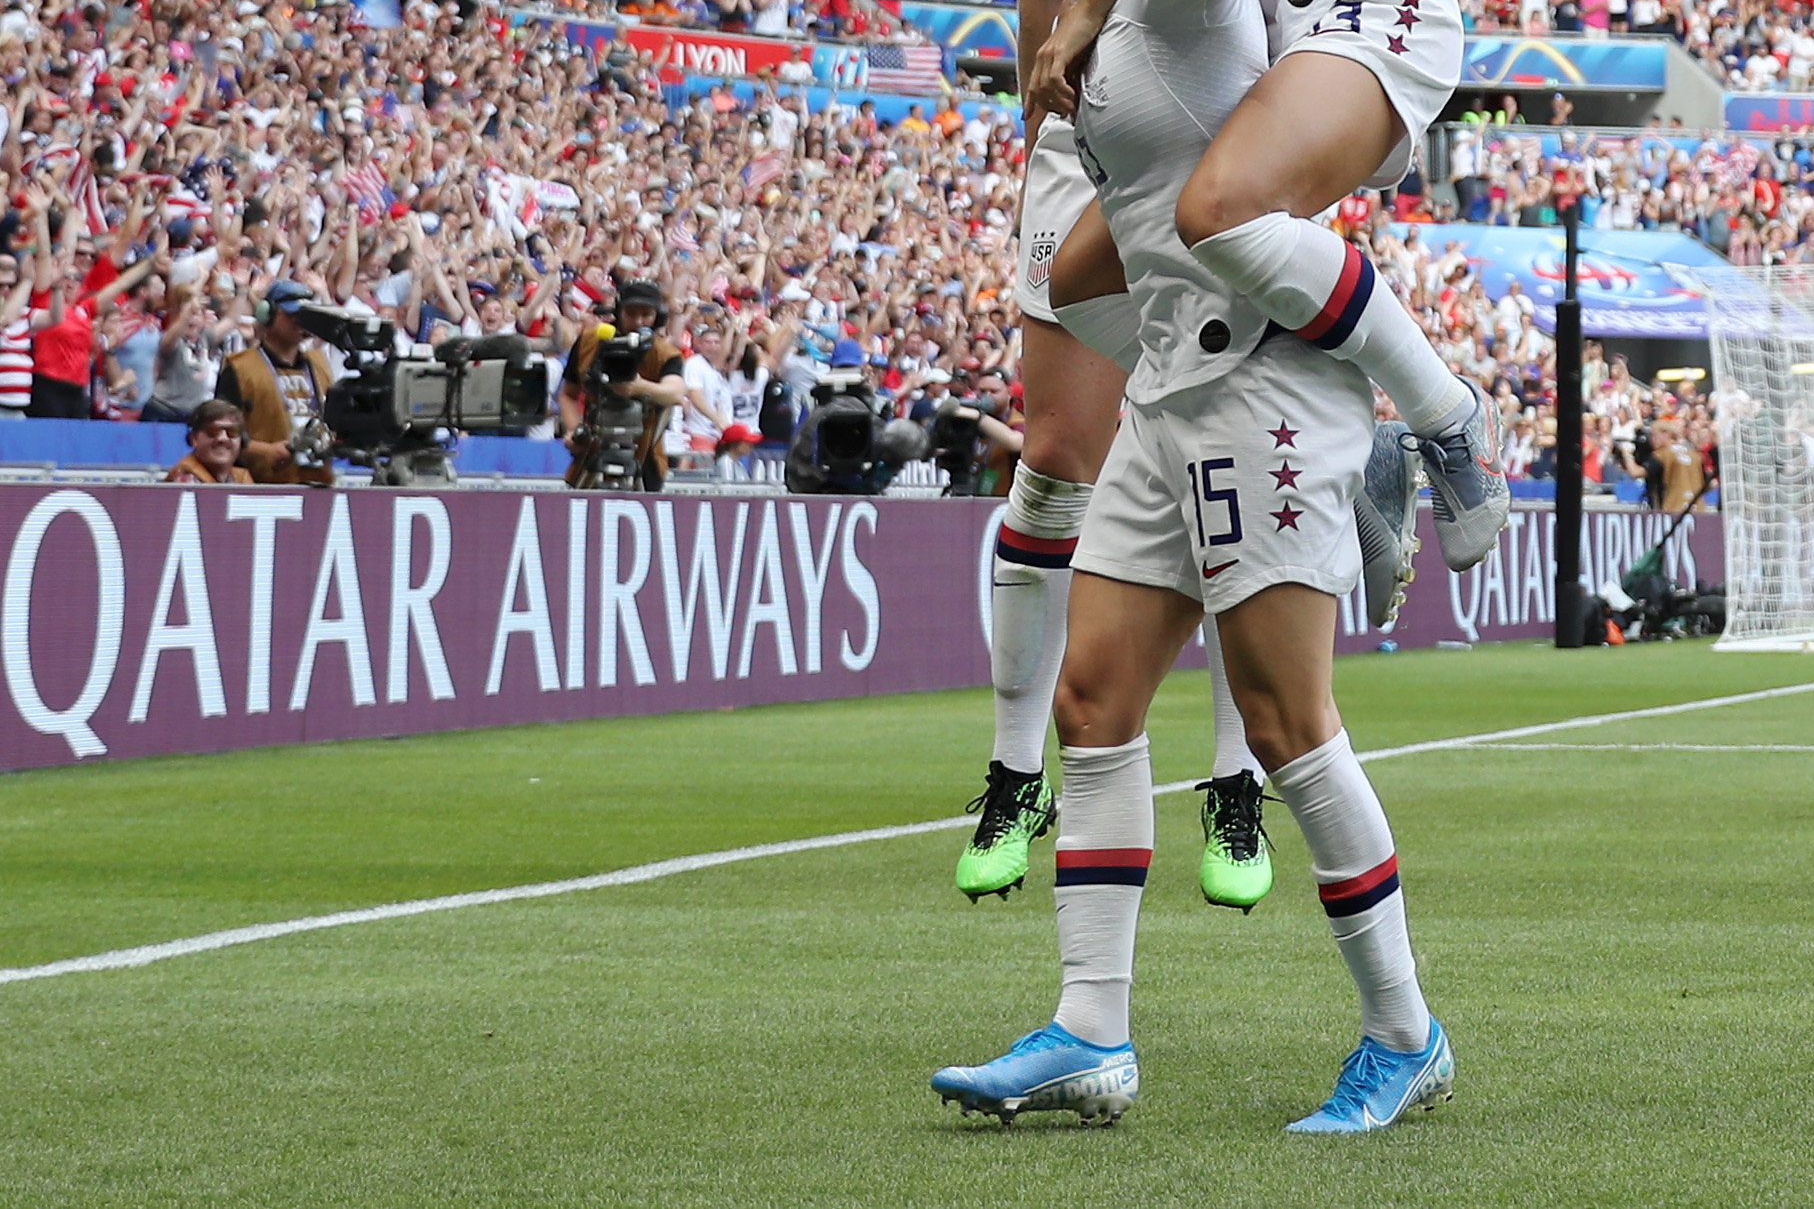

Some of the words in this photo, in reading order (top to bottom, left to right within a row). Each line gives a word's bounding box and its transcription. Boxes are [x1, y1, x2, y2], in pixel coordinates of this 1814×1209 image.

[674, 41, 747, 75] LYON
[1187, 457, 1243, 547] 15
[3, 490, 455, 759] QATAR
[485, 496, 881, 695] AIRWAYS
